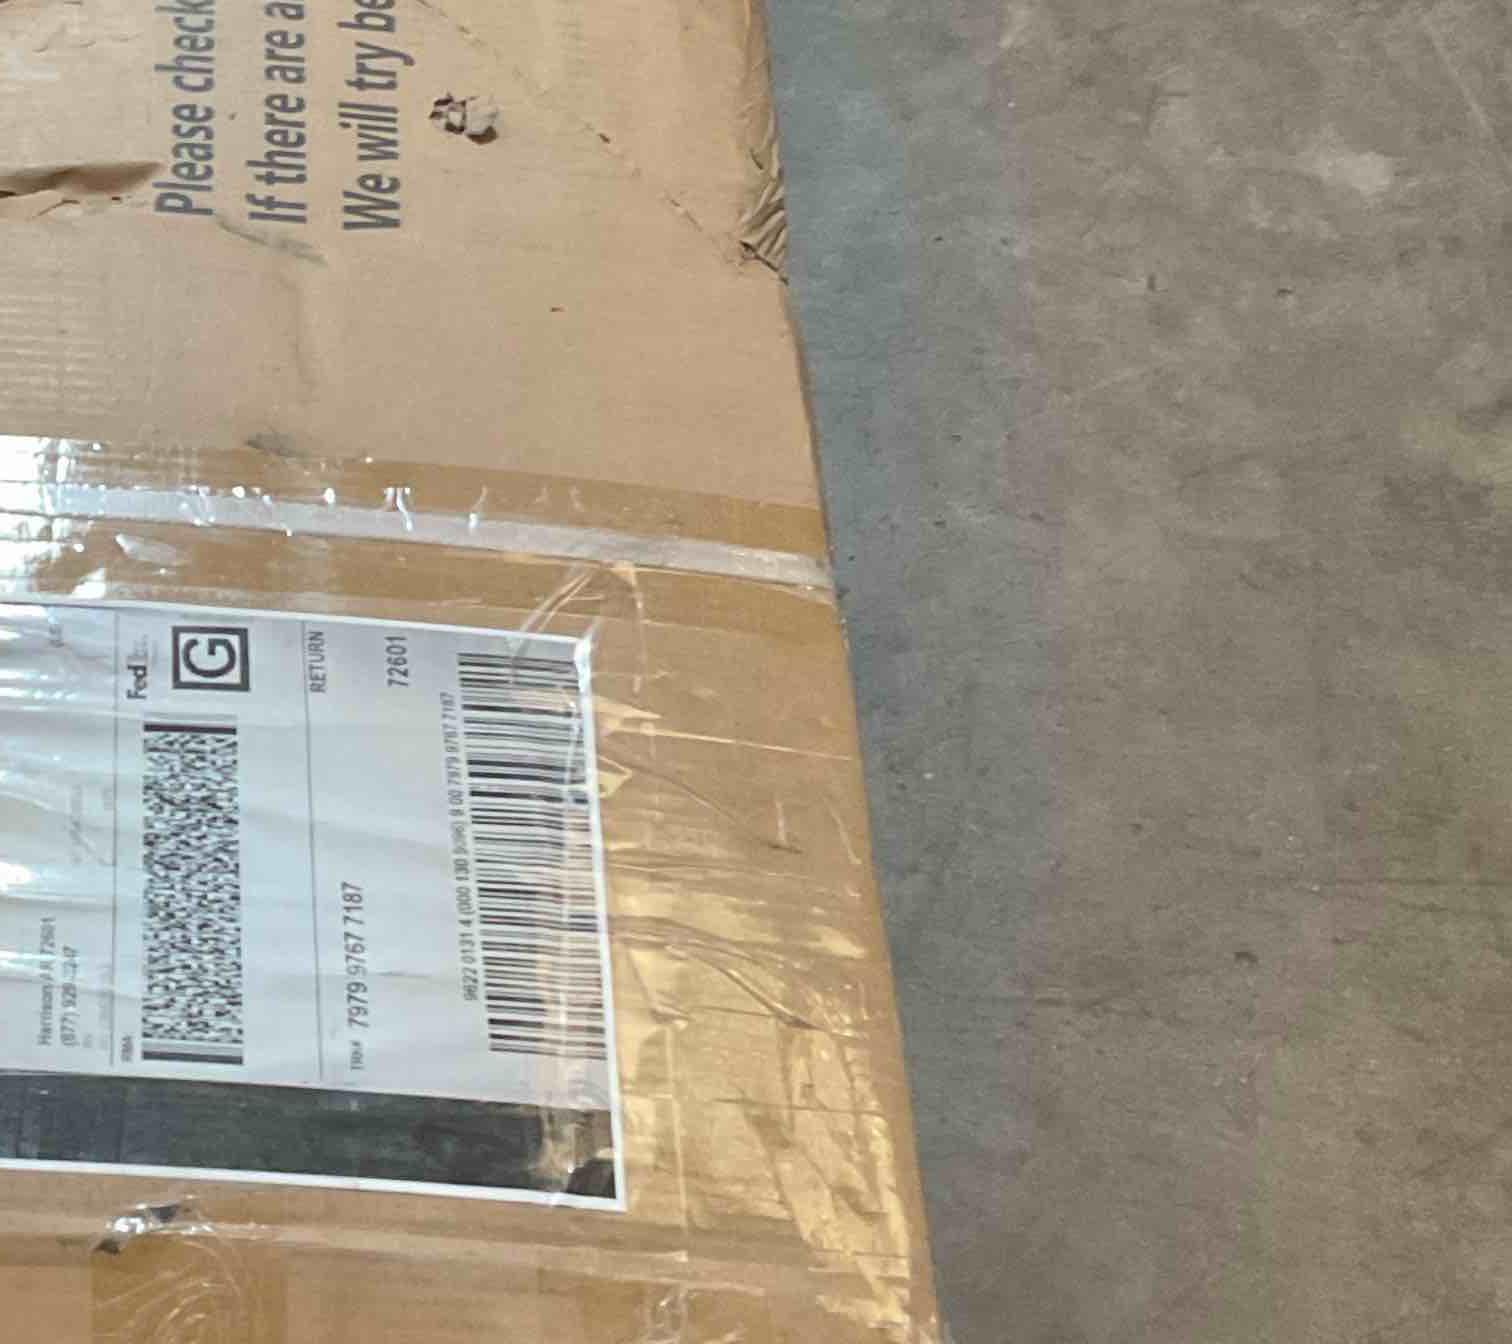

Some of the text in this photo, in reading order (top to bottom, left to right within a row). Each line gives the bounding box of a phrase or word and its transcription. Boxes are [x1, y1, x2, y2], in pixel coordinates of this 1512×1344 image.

[263, 30, 305, 85] are
[344, 42, 414, 92] try
[245, 94, 307, 186] there
[338, 102, 400, 162] will
[152, 104, 215, 216] Please
[245, 193, 307, 225] If
[341, 174, 400, 232] We
[182, 637, 237, 679] G
[307, 630, 328, 694] RETURN
[386, 634, 409, 690] 72601
[340, 882, 364, 926] 7187
[343, 931, 367, 977] 9767
[346, 982, 369, 1028] 7979
